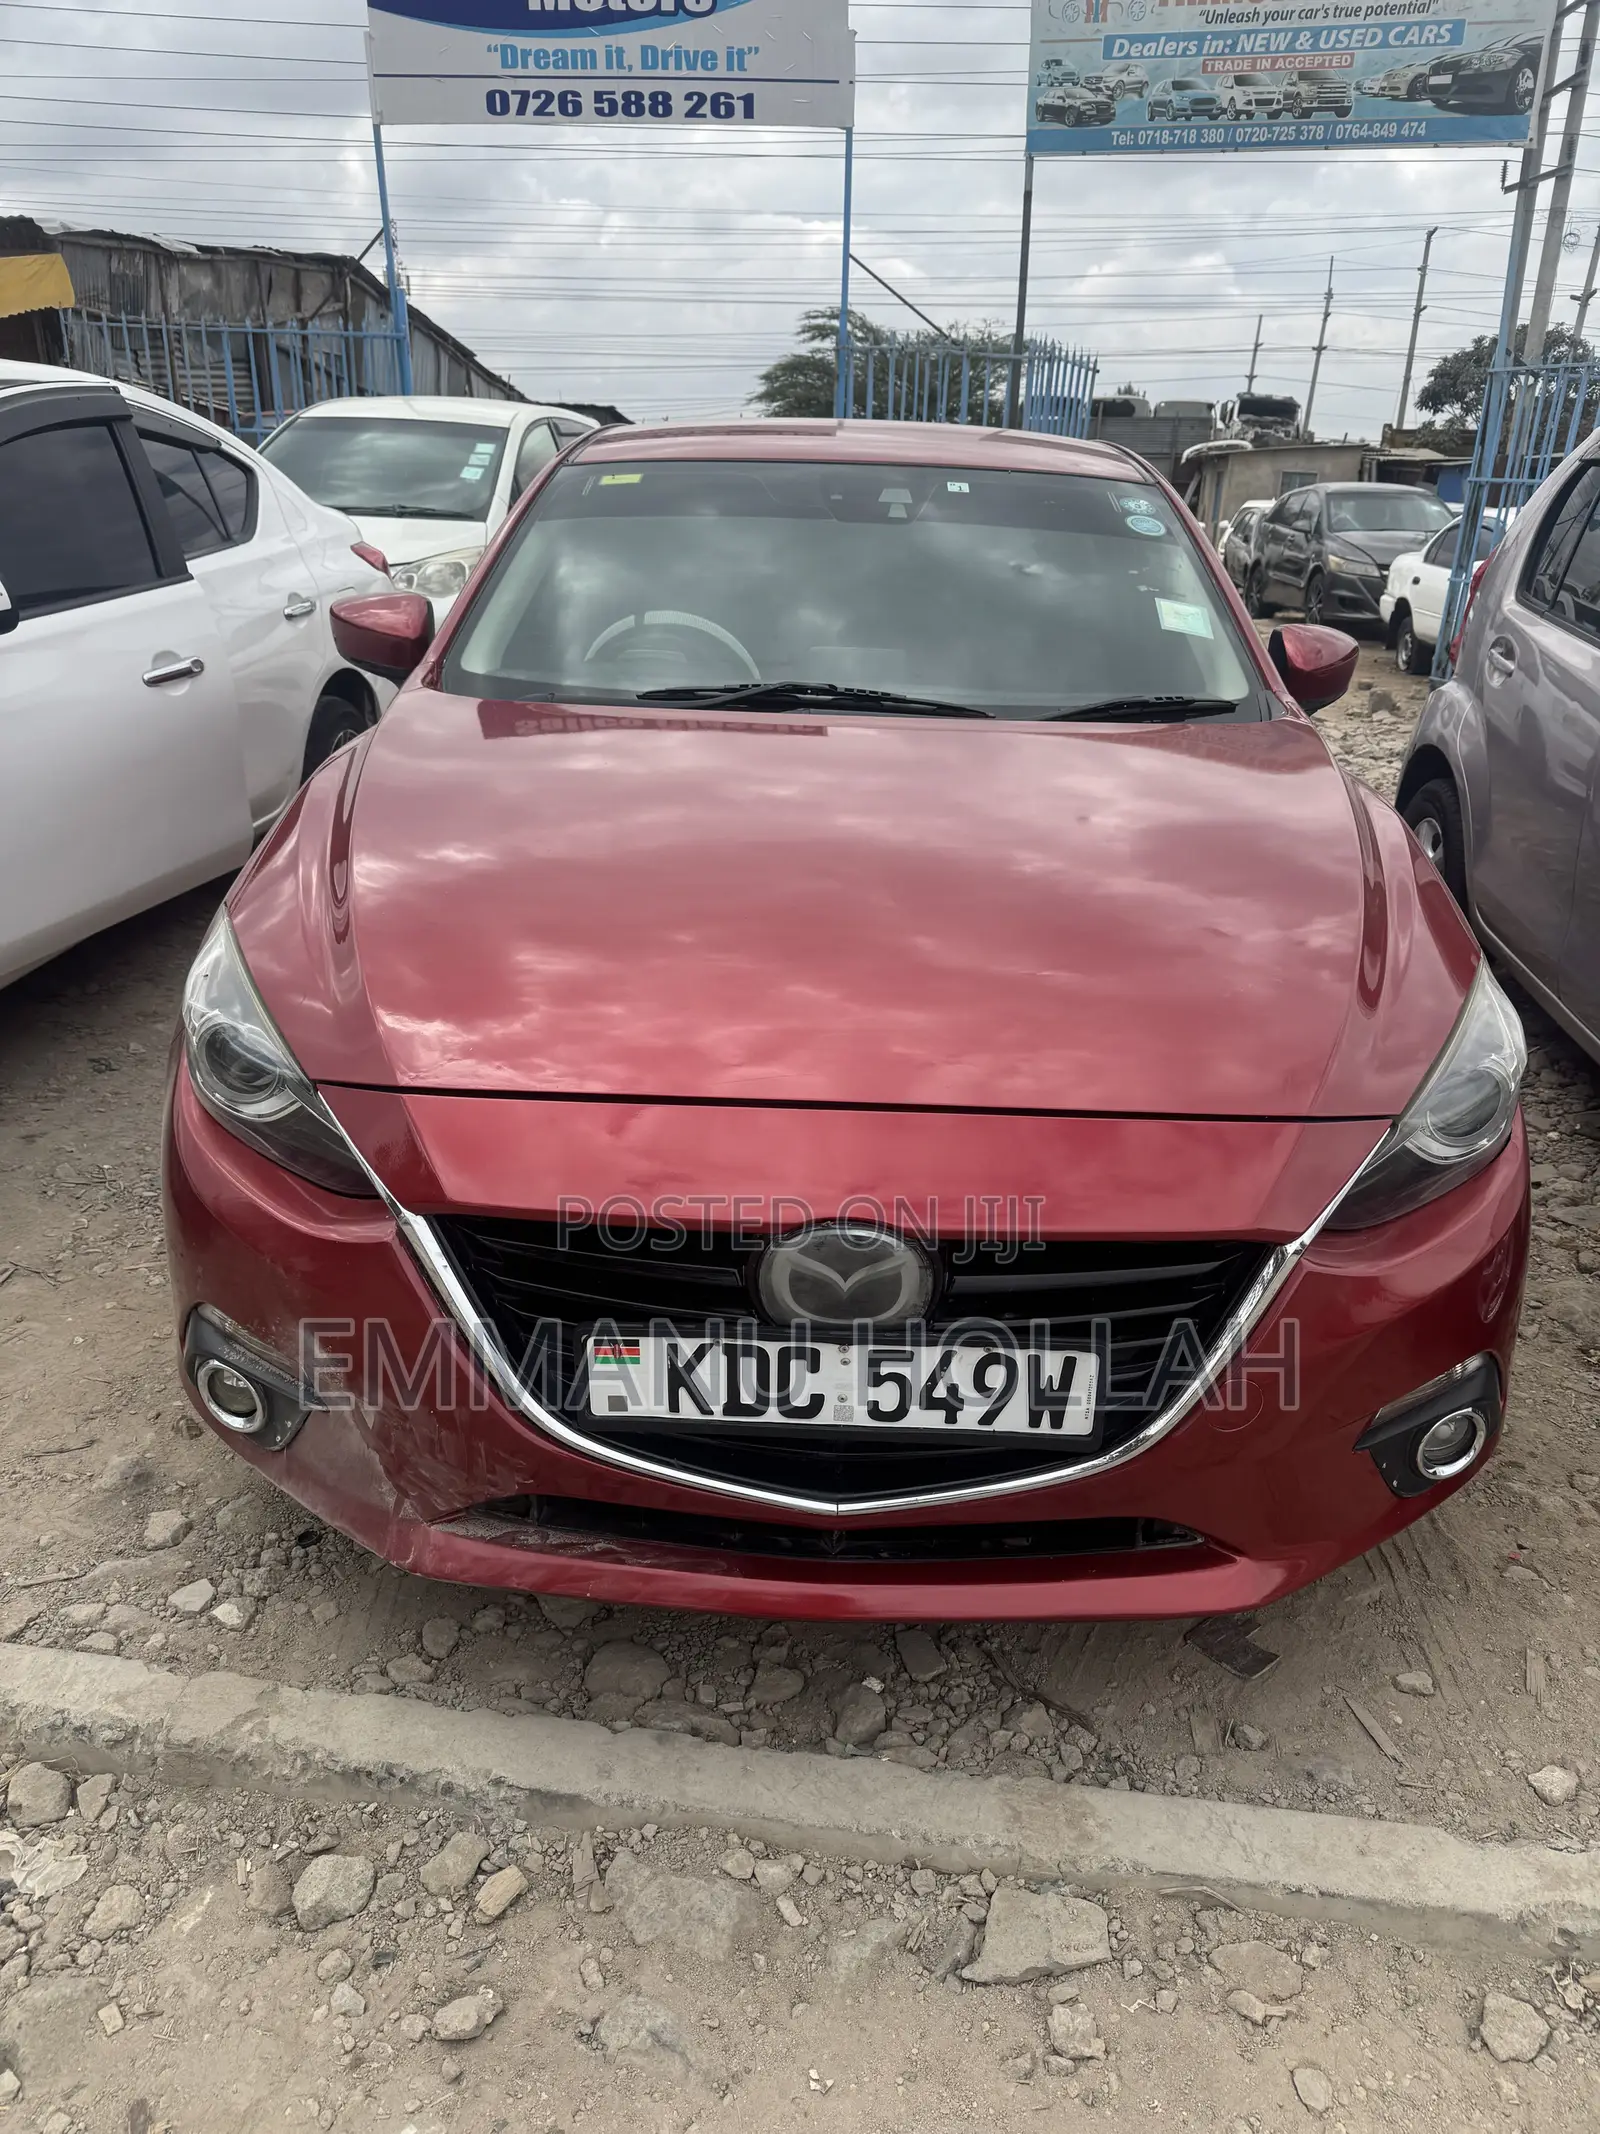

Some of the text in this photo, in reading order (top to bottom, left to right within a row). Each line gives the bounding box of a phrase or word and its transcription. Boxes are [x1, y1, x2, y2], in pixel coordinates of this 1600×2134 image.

[1261, 9, 1296, 26] your
[1297, 4, 1330, 20] car's
[1332, 4, 1362, 19] true
[1111, 24, 1454, 58] Dealers in: NEW & USED CARS
[486, 43, 760, 73] “Dream it, Drive it”
[1205, 54, 1352, 72] TRADE IN ACCEPTED
[485, 89, 755, 119] 0726 588 261
[1111, 120, 1427, 145] Tel: 0718-718 380 / 0720-725 378 / 0764-849 474
[666, 1342, 1078, 1430] KDC 549W
